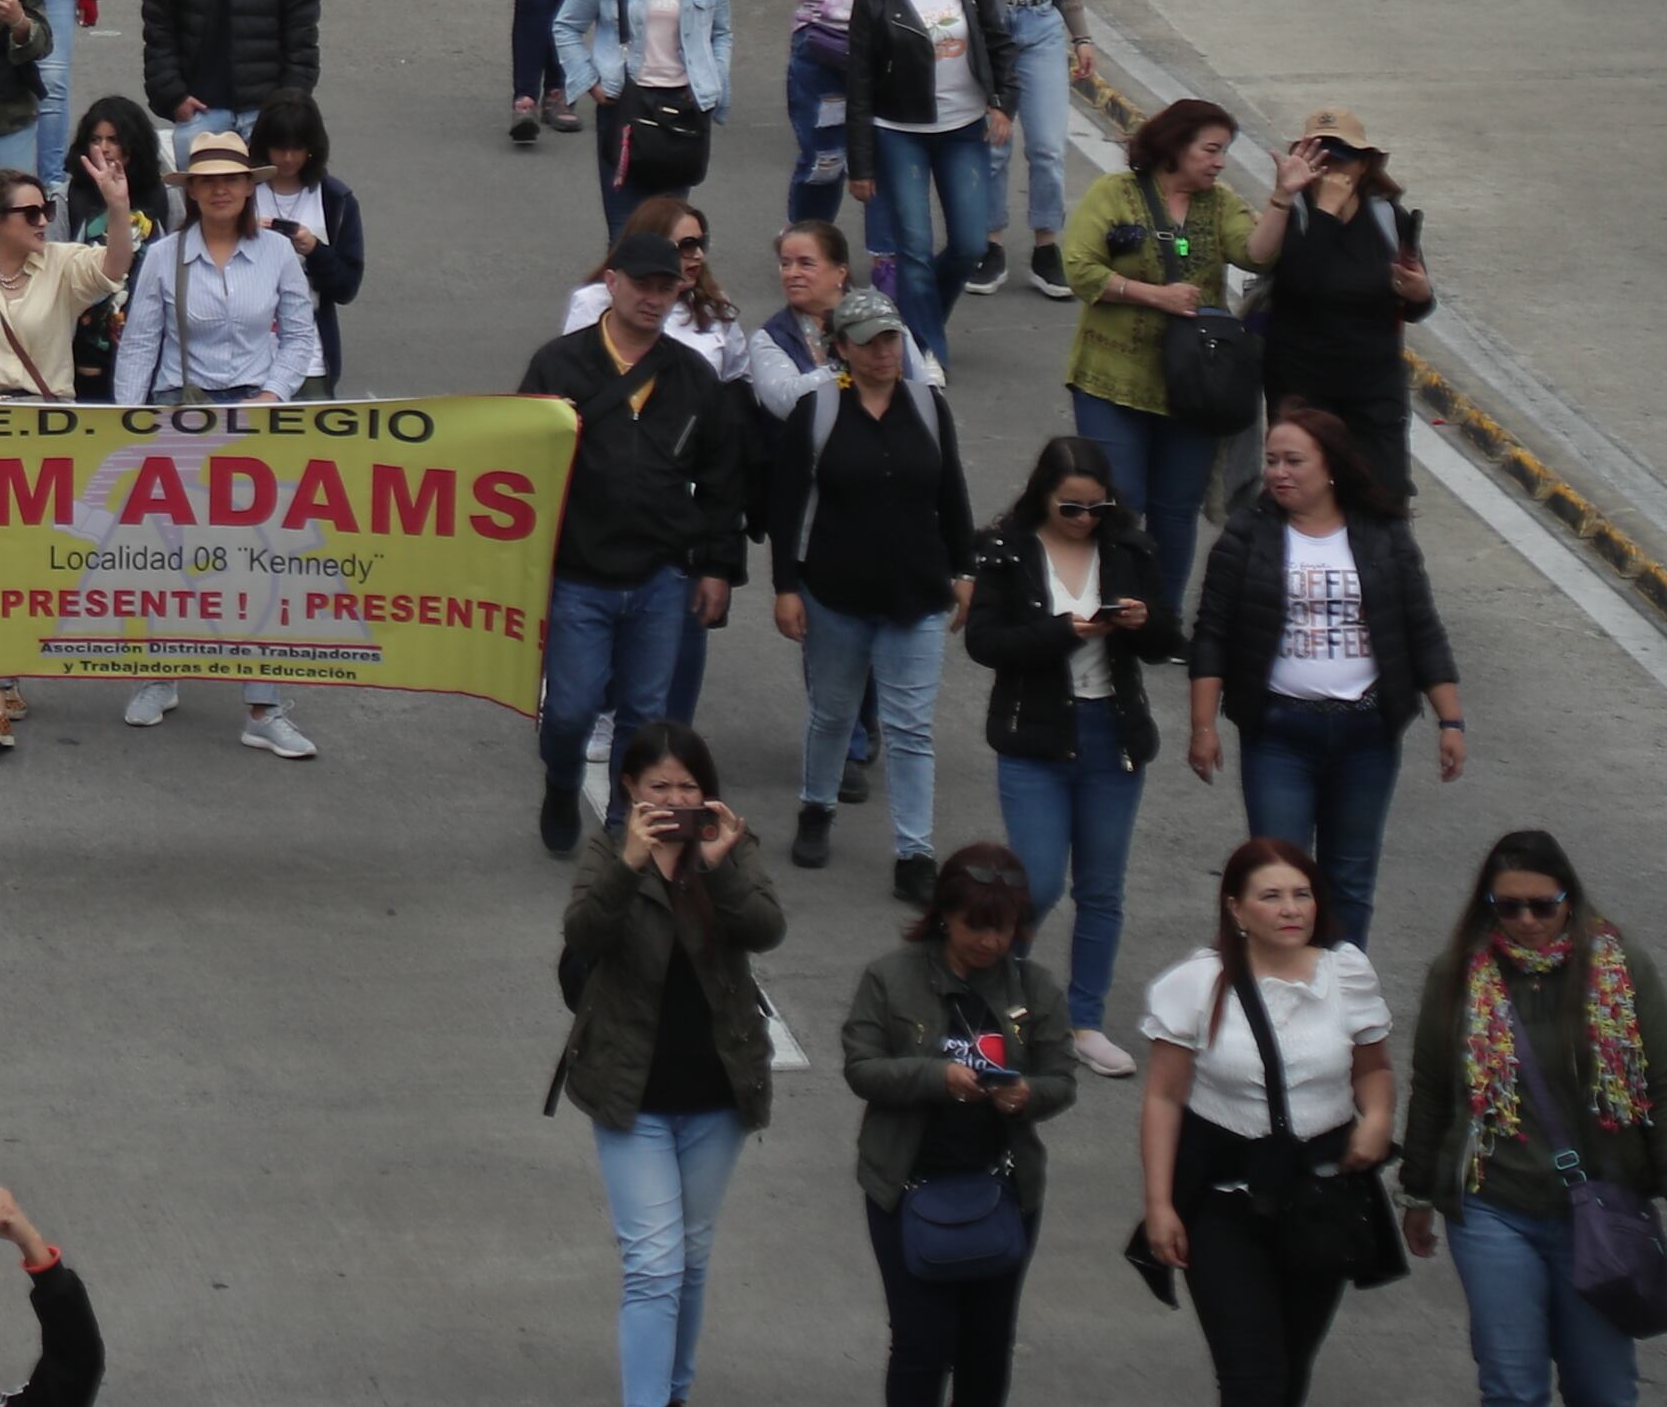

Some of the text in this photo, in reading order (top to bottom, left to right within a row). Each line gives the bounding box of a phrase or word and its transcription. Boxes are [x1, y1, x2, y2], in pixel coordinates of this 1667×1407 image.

[121, 405, 436, 444] COLEGIO
[119, 456, 538, 542] ADAMS
[49, 544, 184, 572] Localidad
[193, 547, 229, 573] 08
[1, 589, 223, 620] PRESENTE
[306, 591, 526, 644] PRESENTE
[40, 641, 382, 663] Asociación Distrital de Trabajadores
[63, 660, 358, 681] y Trabajadoras de la Educación
